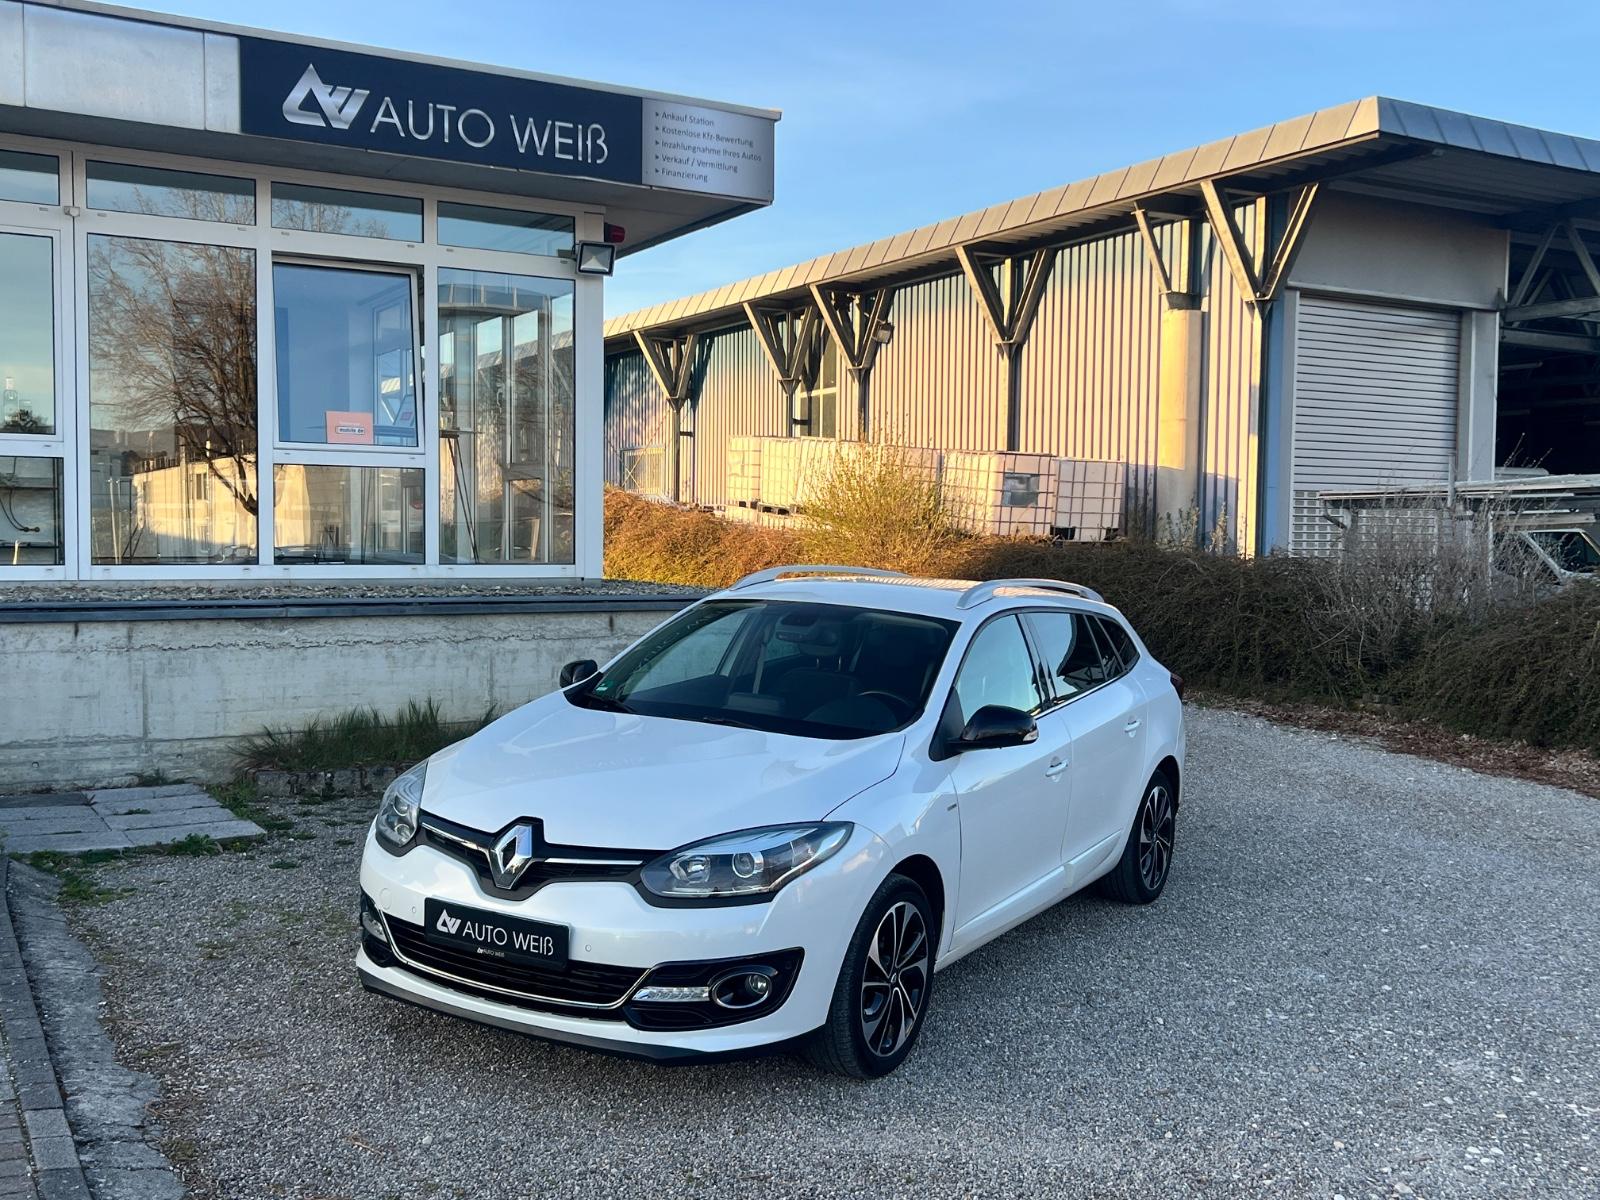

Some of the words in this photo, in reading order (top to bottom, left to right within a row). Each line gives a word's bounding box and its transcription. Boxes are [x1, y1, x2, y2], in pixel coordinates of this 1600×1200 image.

[370, 96, 495, 149] AUTO
[509, 114, 609, 164] WEIß
[662, 111, 687, 123] Ankauf
[689, 116, 714, 127] Station
[662, 125, 701, 139] Kostenlose
[702, 133, 754, 148] Kfz-Bewertung
[662, 139, 721, 155] Inzahlungnahme
[723, 149, 740, 159] Ihres
[741, 152, 762, 162] Autos
[662, 154, 690, 167] Verkauf
[662, 168, 708, 183] Finanzierung
[463, 921, 508, 945] AUTO
[512, 931, 554, 956] WEIß
